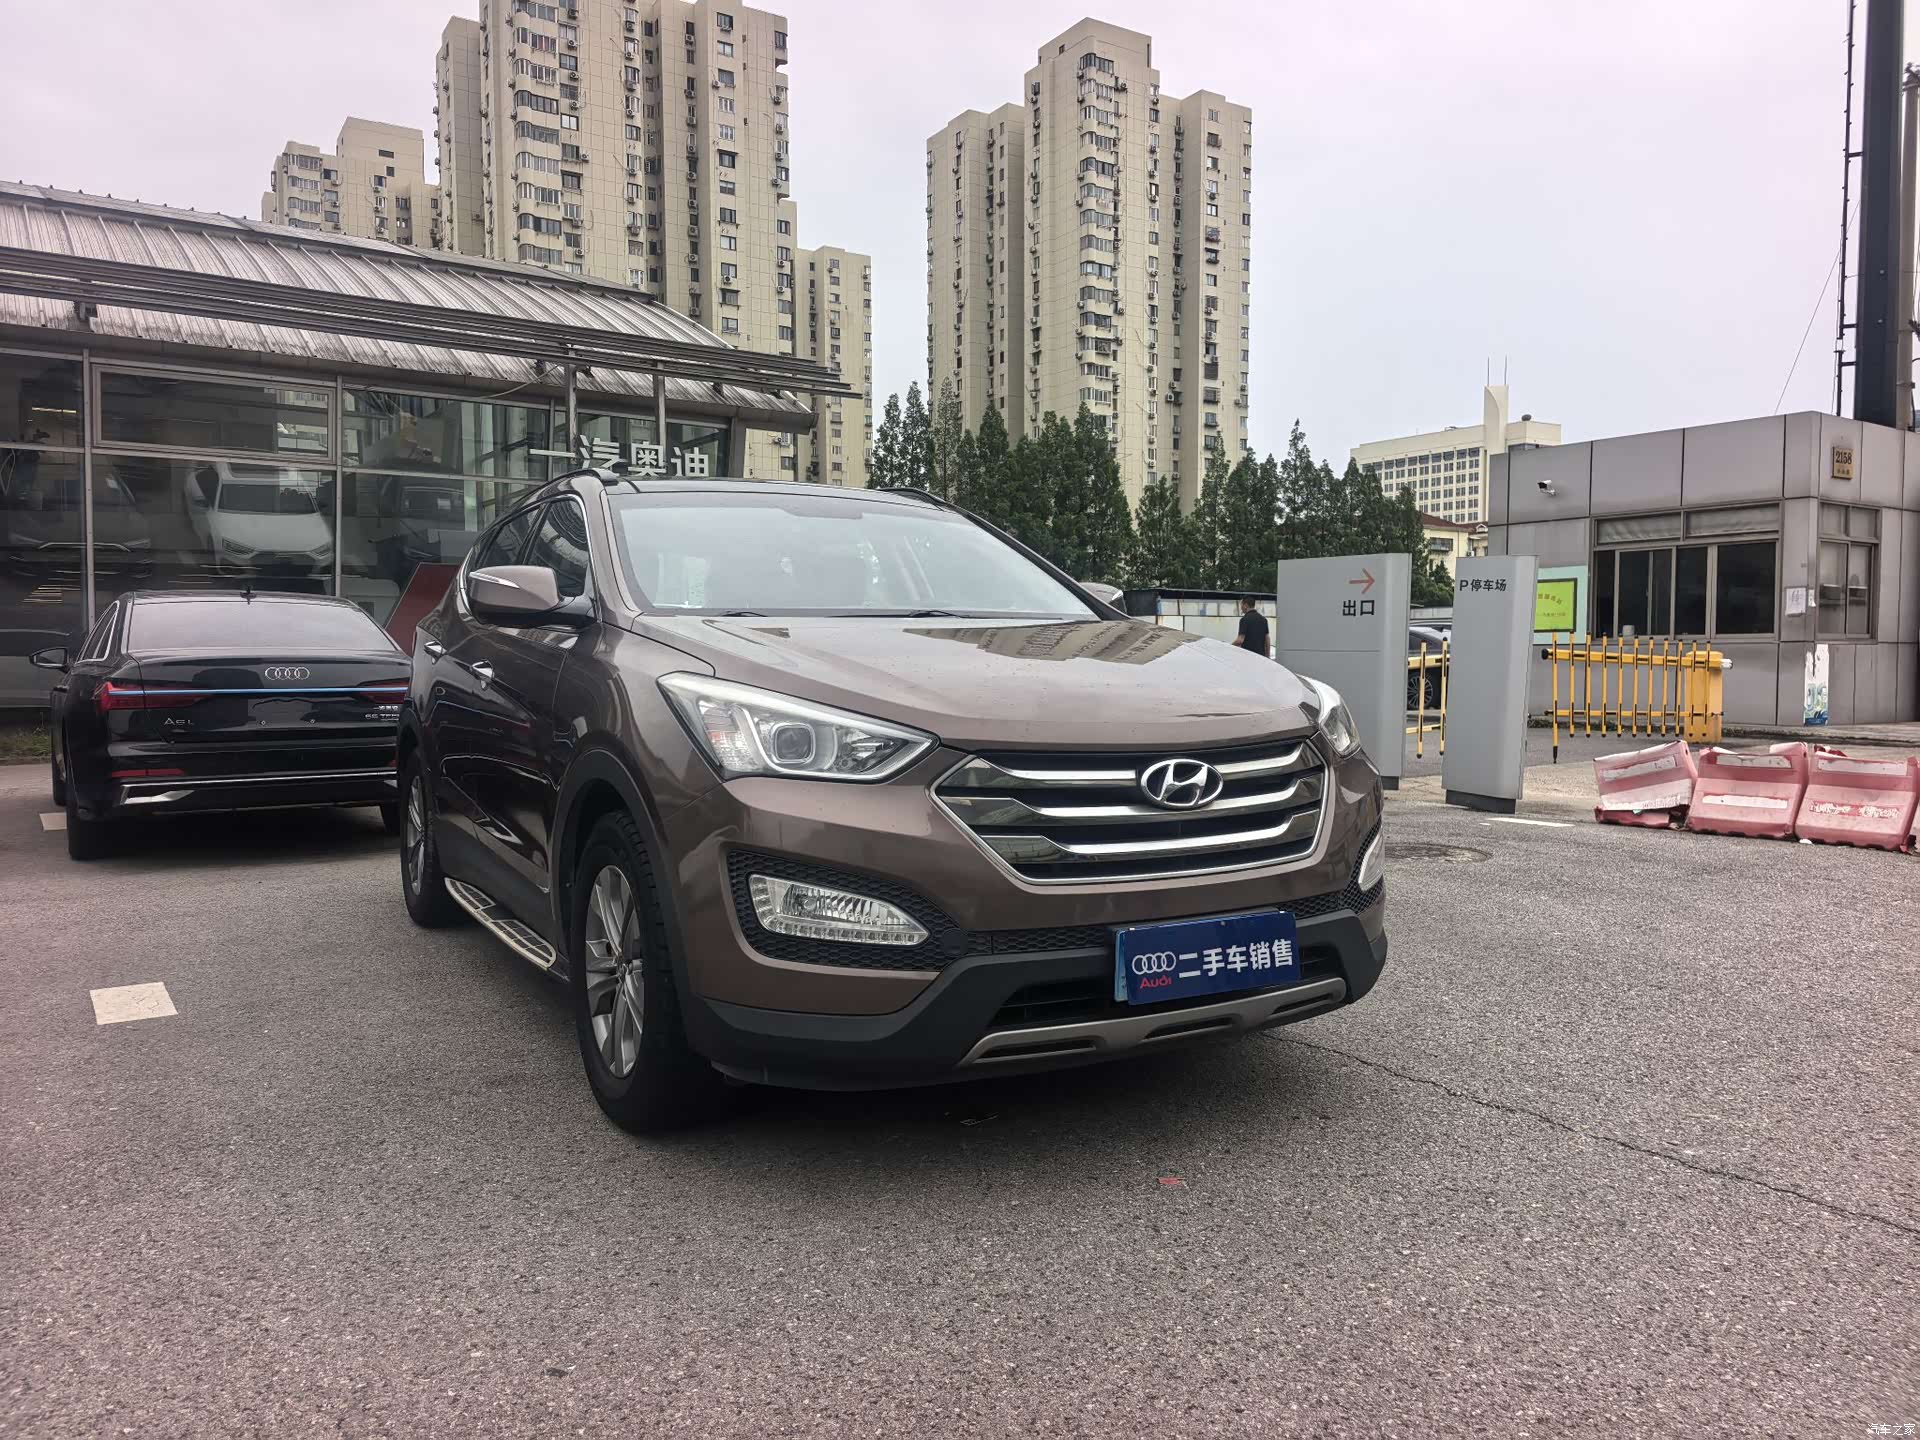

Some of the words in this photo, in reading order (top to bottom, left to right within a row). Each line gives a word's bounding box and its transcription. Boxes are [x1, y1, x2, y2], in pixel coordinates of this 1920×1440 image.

[529, 434, 709, 477] 一汽奥迪
[1835, 450, 1853, 464] 2158
[1342, 600, 1375, 616] 出口
[1178, 938, 1293, 978] 二手车销售
[1140, 974, 1172, 989] Audi
